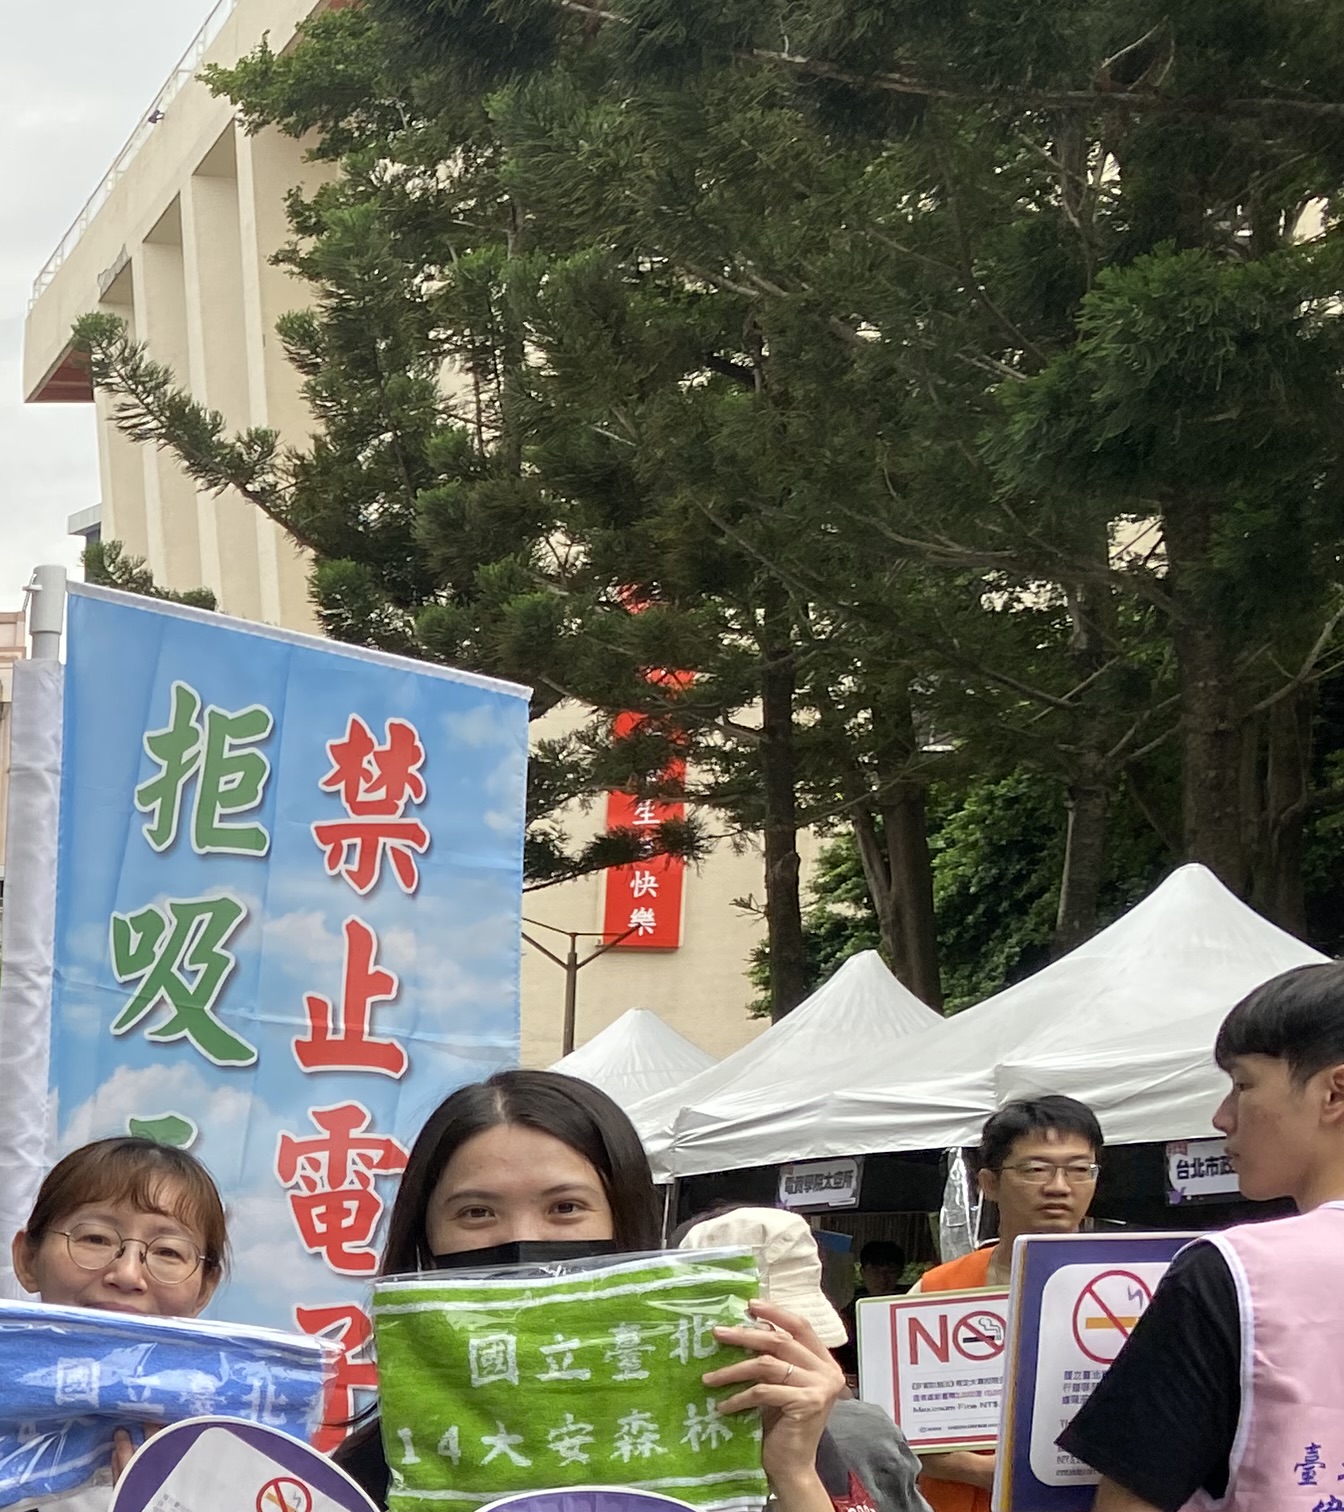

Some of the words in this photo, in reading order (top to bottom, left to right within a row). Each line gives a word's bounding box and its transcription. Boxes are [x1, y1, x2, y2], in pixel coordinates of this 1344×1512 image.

[109, 681, 274, 1148] 拒吸
[627, 799, 661, 937] 生快樂
[395, 1397, 762, 1469] 14大安森林
